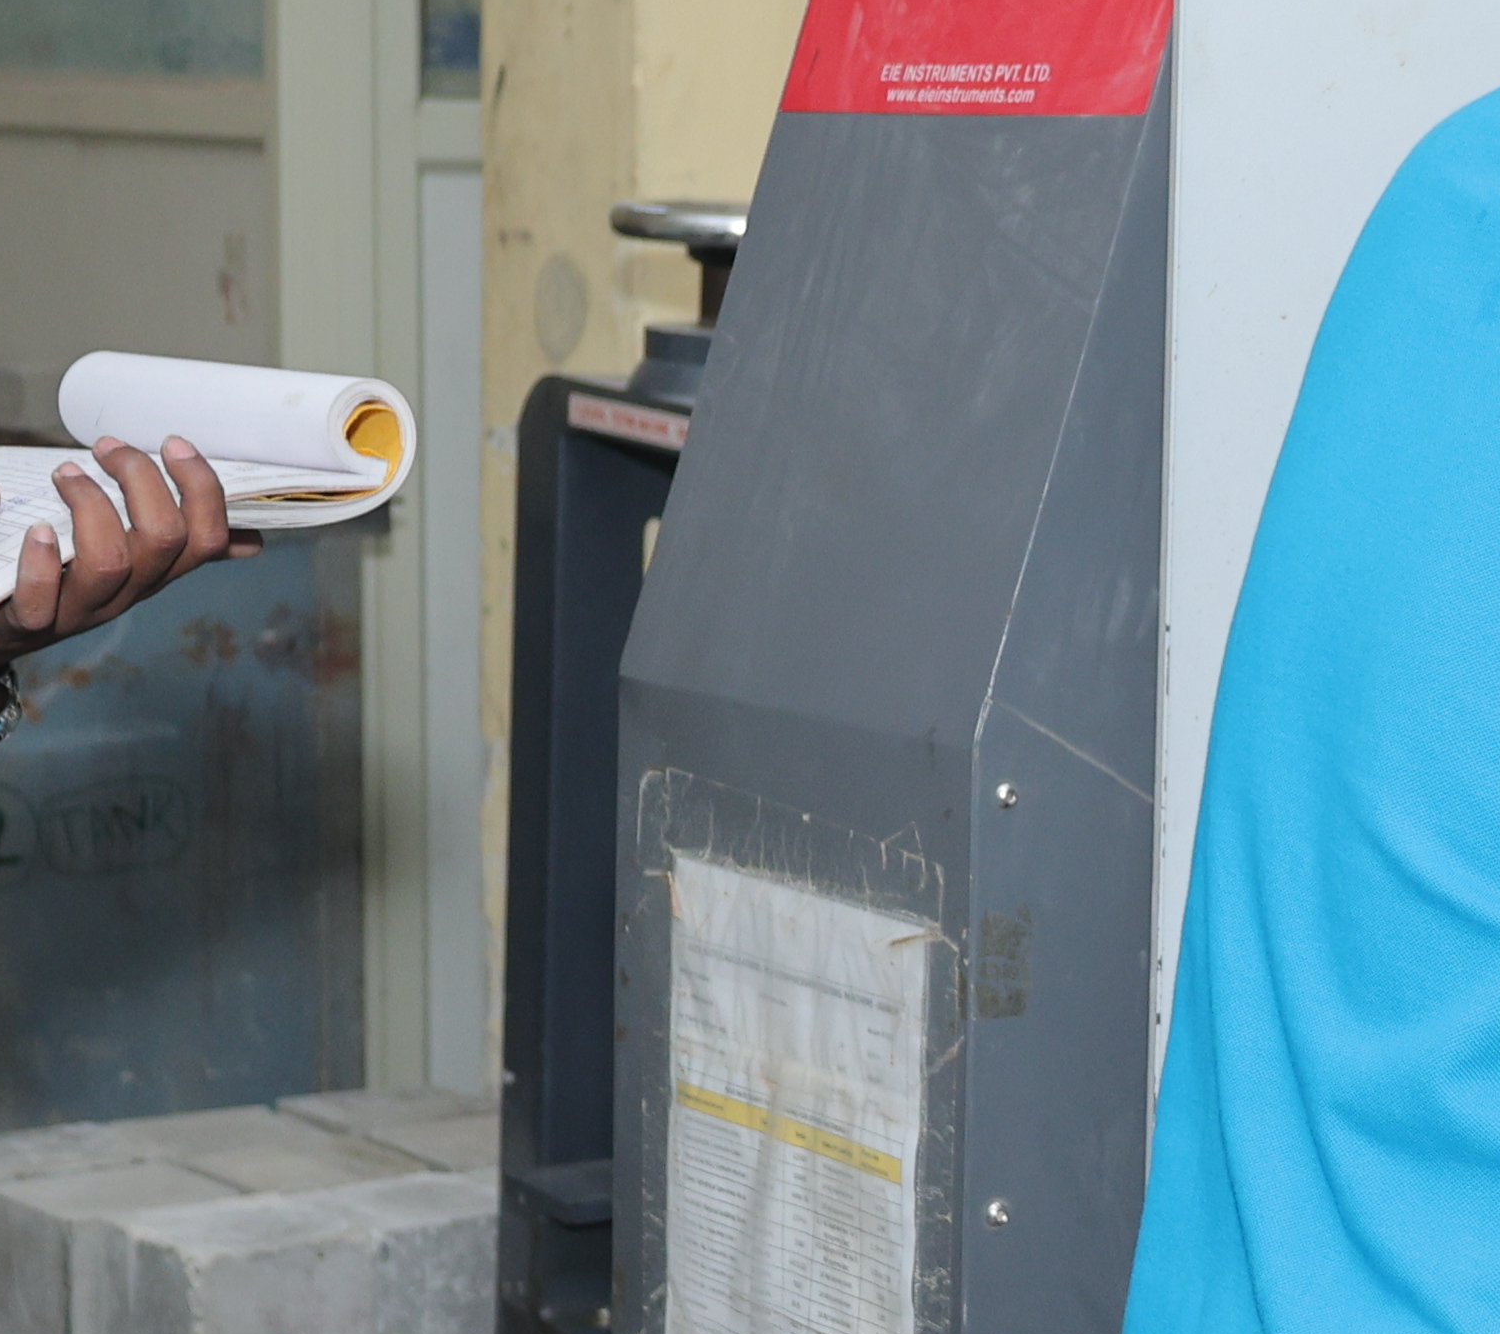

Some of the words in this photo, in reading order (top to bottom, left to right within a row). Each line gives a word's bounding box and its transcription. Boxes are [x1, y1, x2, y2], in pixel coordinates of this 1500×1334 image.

[880, 64, 900, 82] EIE
[902, 63, 994, 82] INSTRUMENTS
[994, 64, 1021, 82] PVT.
[1023, 64, 1051, 82] LTD.
[886, 85, 1036, 104] www.eieinstruments.com
